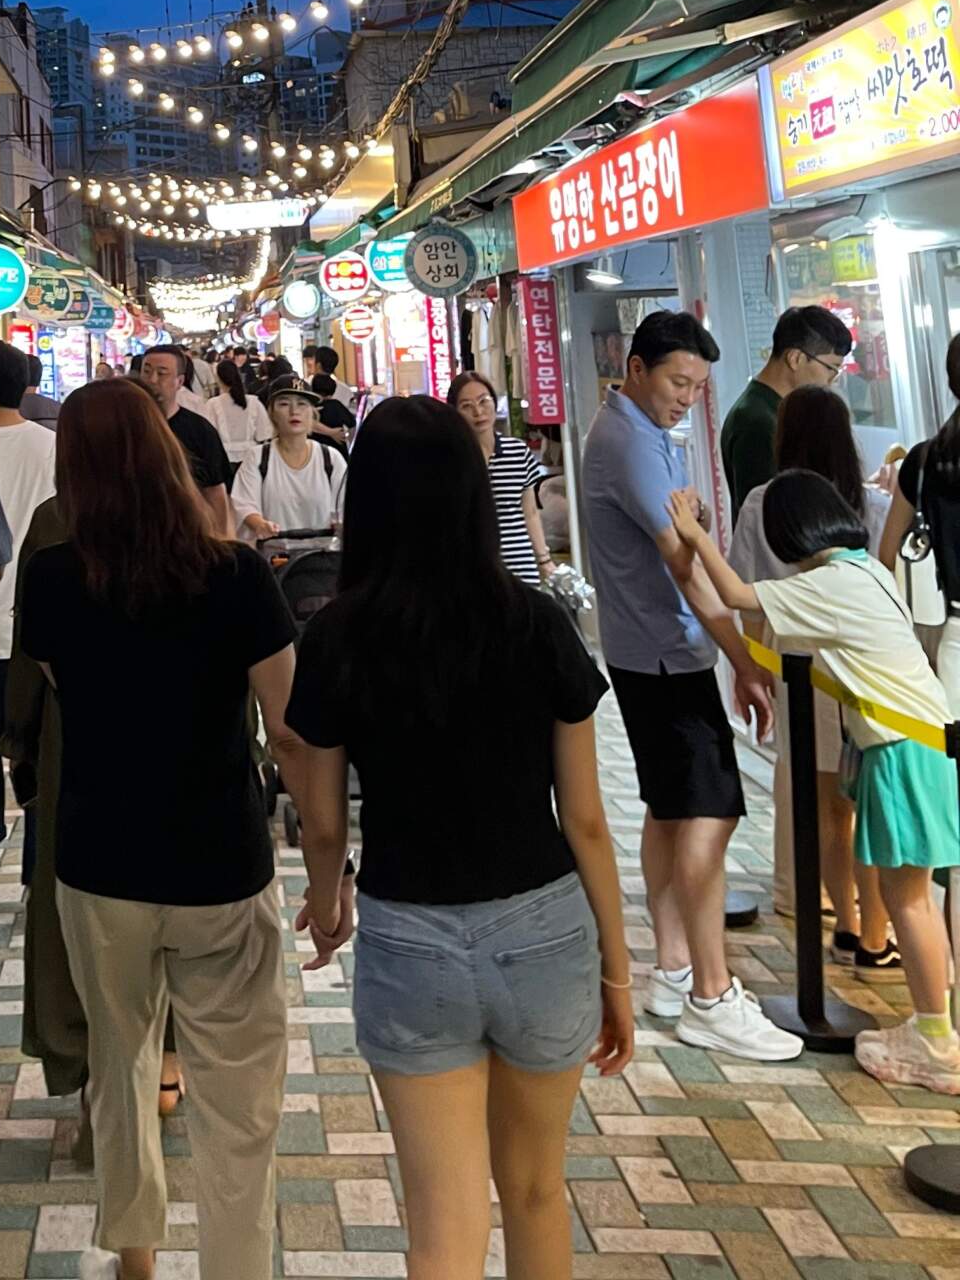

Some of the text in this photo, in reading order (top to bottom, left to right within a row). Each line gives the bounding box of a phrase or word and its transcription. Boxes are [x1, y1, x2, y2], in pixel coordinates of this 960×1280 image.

[868, 37, 953, 116] 씨앗호떡
[548, 129, 685, 253] 유명한 산곰장어
[423, 240, 458, 261] 함안
[425, 263, 460, 284] 상회
[530, 287, 559, 418] 연탄전문점
